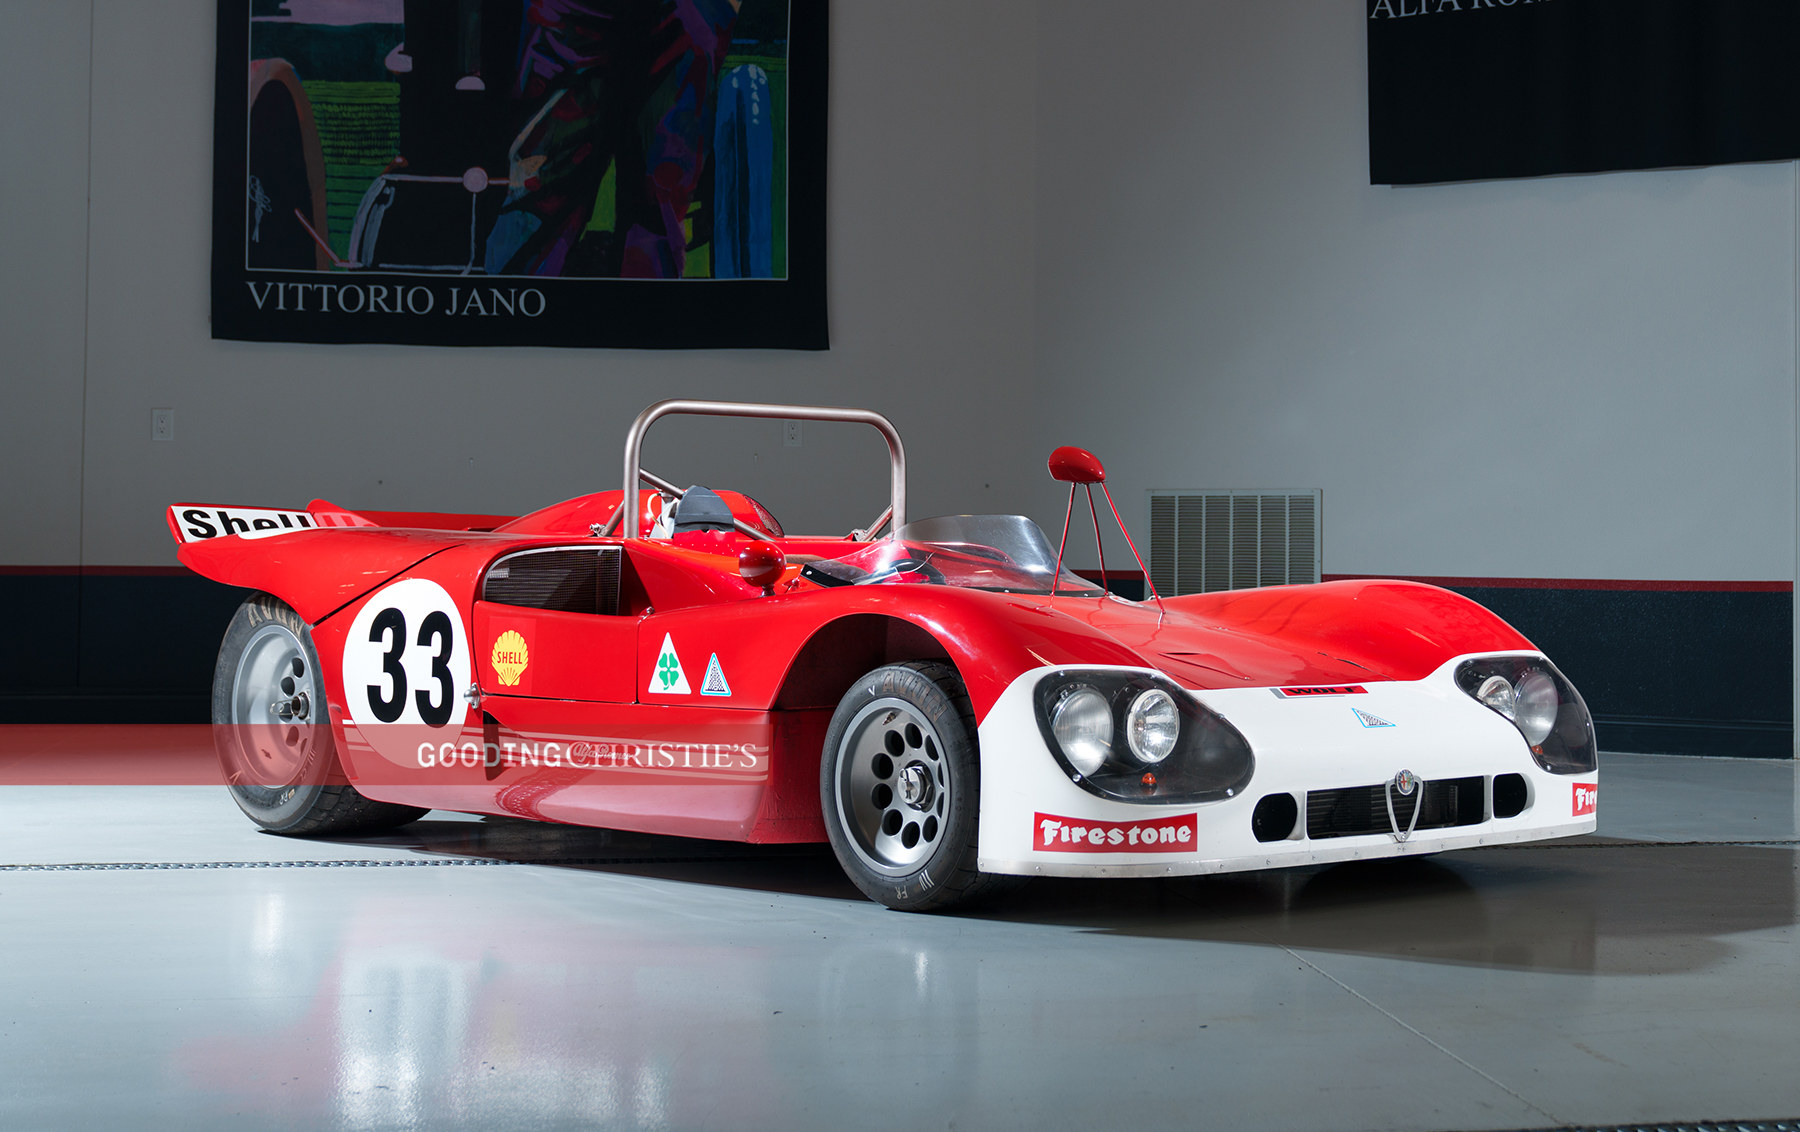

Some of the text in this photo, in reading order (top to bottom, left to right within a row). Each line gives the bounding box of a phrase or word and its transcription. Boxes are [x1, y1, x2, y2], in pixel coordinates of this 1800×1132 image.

[245, 281, 547, 318] VITTORIO JANO
[366, 607, 454, 729] 33
[497, 651, 523, 665] SHELL
[1040, 819, 1192, 846] Firestone
